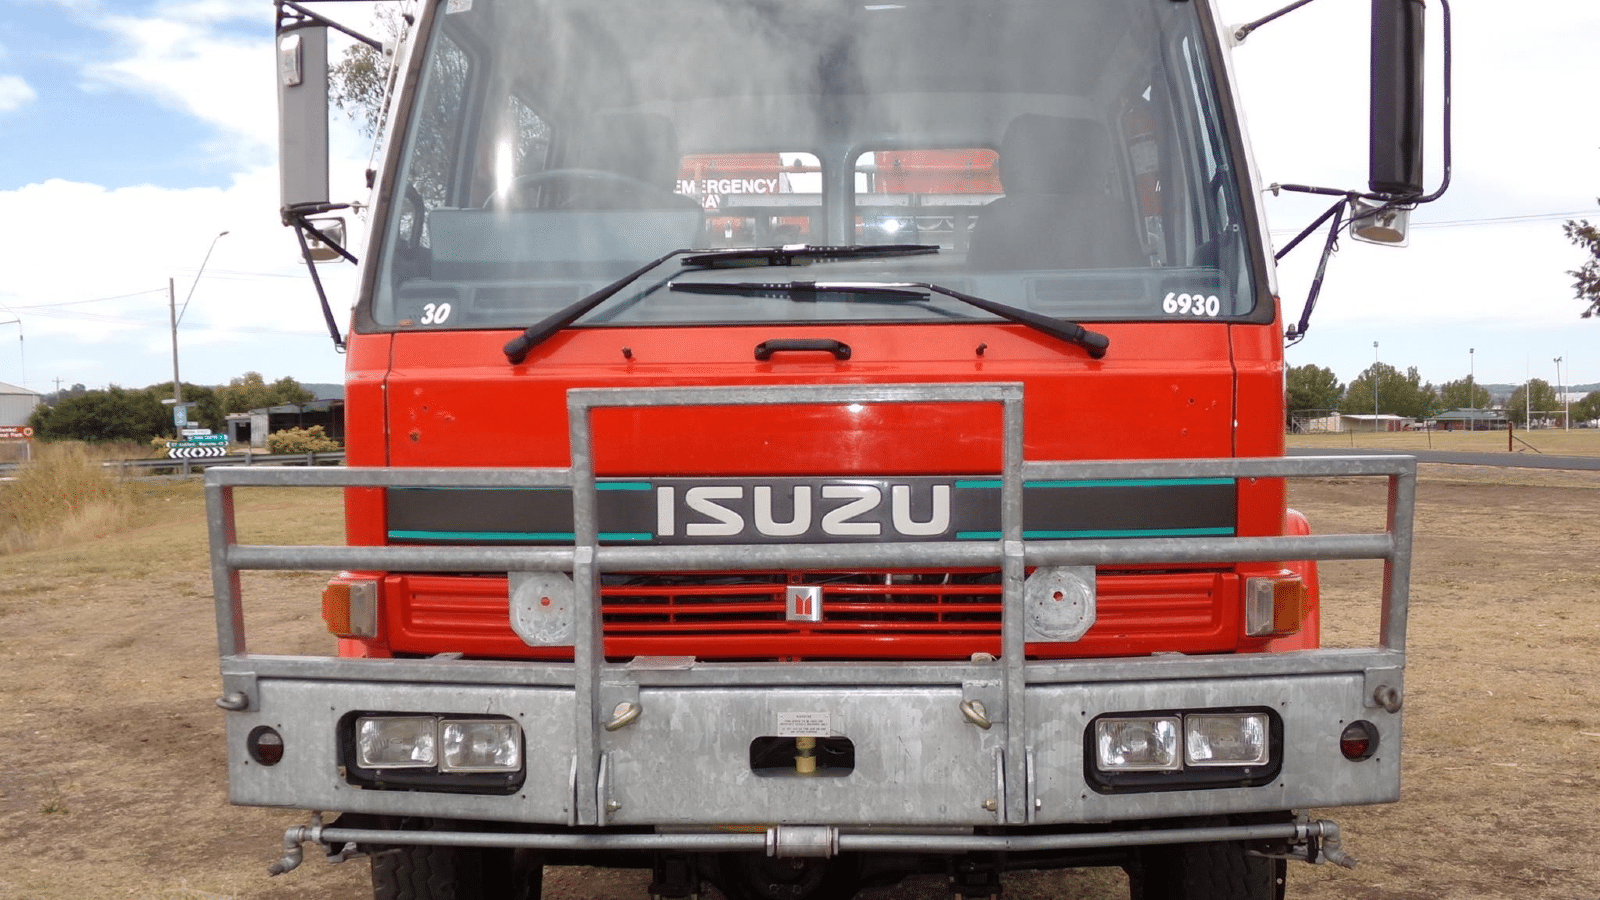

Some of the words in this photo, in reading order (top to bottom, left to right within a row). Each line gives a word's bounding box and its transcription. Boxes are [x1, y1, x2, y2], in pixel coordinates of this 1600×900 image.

[673, 179, 778, 194] EMERGENCY
[420, 302, 451, 325] 30
[1162, 292, 1220, 317] 6930
[656, 485, 950, 537] ISUZU
